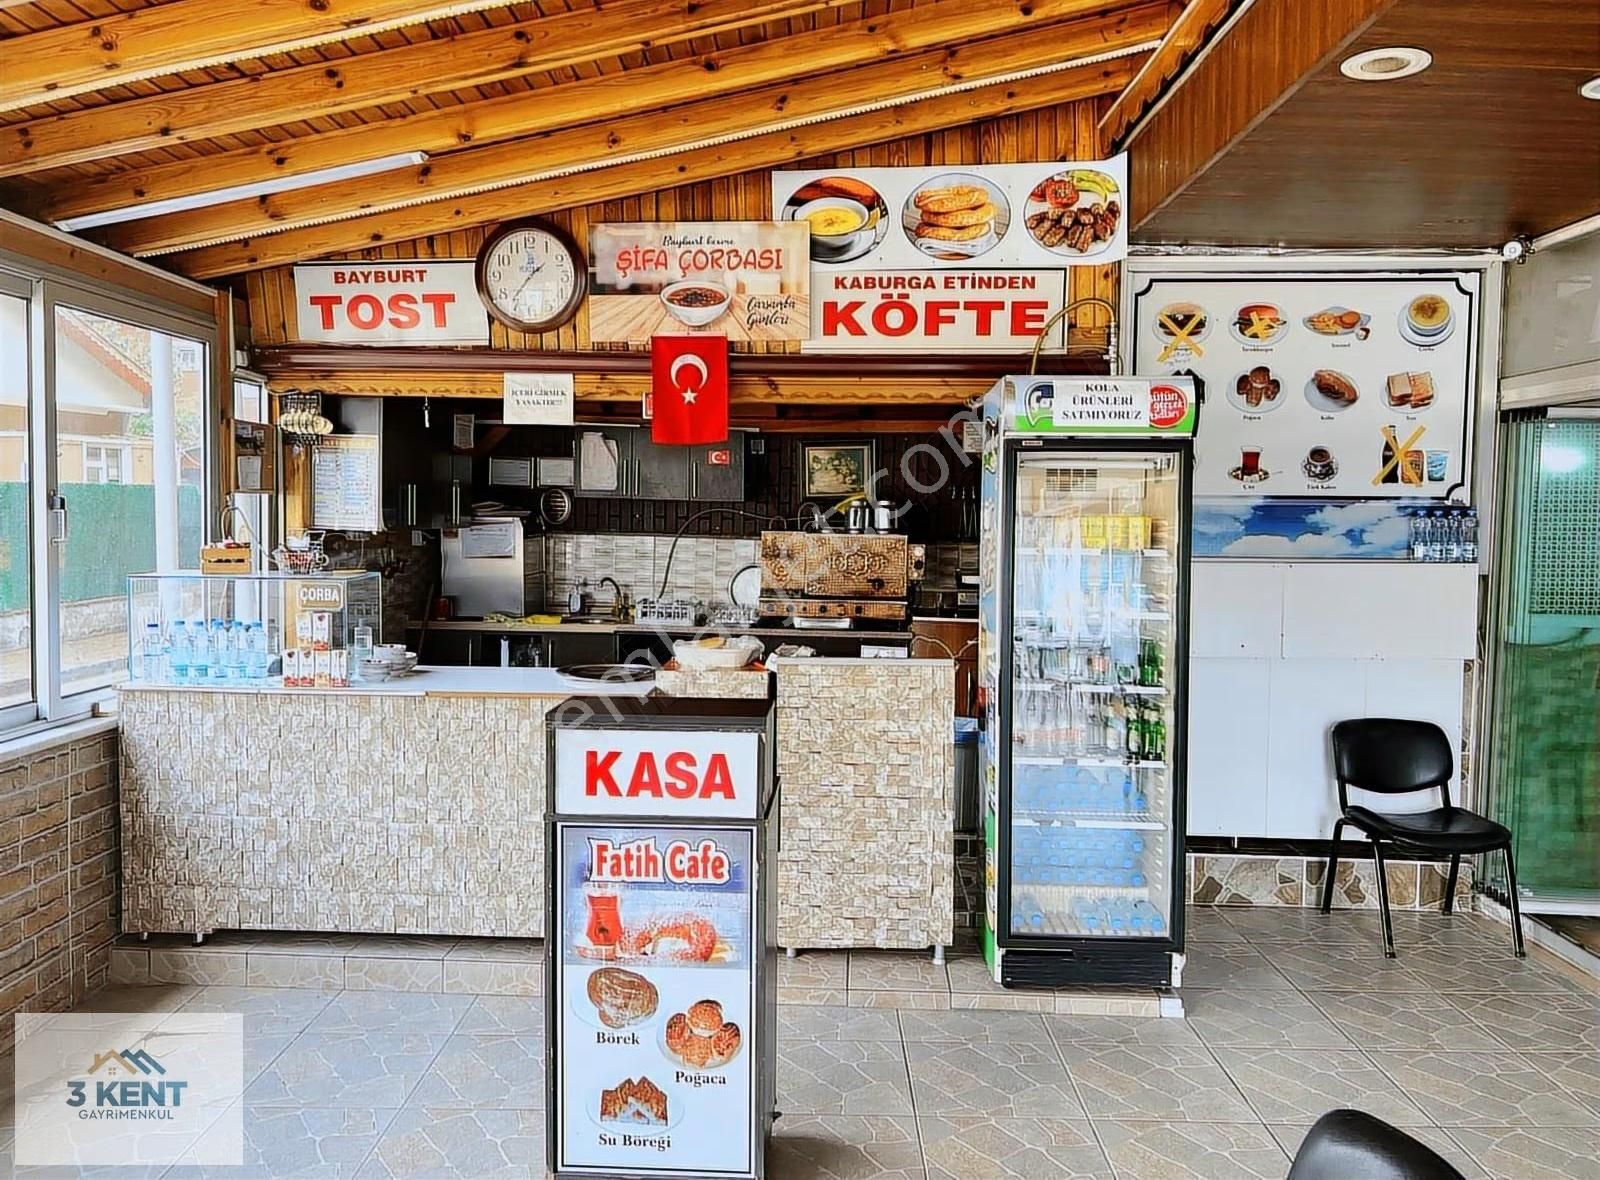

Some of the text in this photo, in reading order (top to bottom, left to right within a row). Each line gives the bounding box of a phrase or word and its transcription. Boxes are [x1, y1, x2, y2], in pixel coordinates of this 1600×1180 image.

[616, 246, 783, 278] ŞİFA ÇORBASI
[333, 269, 427, 284] BAYBURT
[834, 273, 1036, 290] KABURGA ETİNDEN
[309, 294, 456, 330] TOST
[822, 293, 1050, 337] KÖFTE
[1085, 384, 1119, 392] KOLA
[1072, 396, 1134, 406] ÜRÜNLERİ
[1062, 411, 1142, 421] SATMIYORUZ
[300, 587, 340, 604] ÇORBA
[585, 750, 736, 800] KASA
[596, 844, 726, 880] Fatih Cafe
[596, 1031, 640, 1045] Börek
[599, 1133, 671, 1151] Su Böreği
